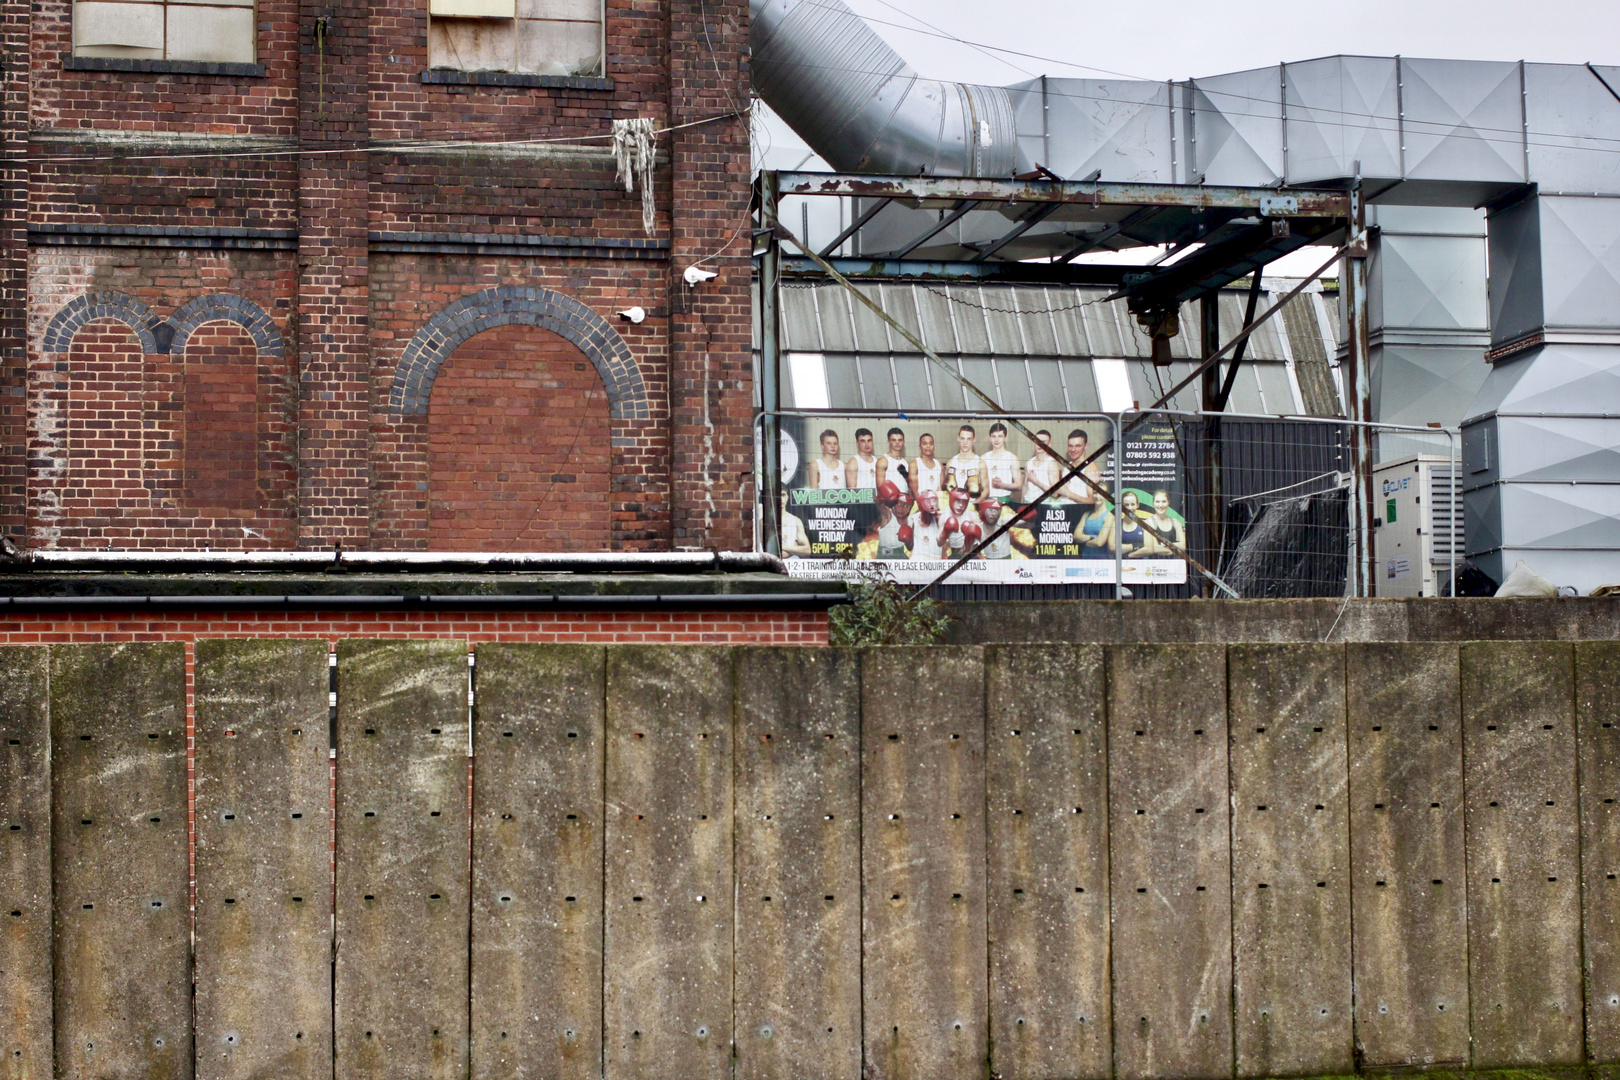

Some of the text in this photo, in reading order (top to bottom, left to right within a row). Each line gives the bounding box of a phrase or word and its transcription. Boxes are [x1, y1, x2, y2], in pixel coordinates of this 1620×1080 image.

[792, 489, 874, 504] WELCOME
[815, 508, 848, 518] MONDAY
[1046, 510, 1066, 520] ALSO
[808, 520, 856, 530] WEDNESDAY
[1041, 521, 1070, 532] SUNDAY
[818, 532, 846, 542] FRIDAY
[1039, 532, 1074, 544] MORNING
[812, 543, 830, 554] 5PM
[1035, 544, 1056, 555] 11AM
[1062, 544, 1079, 555] 1PM
[807, 562, 837, 570] TRAINING
[895, 562, 918, 570] PLEASE
[920, 562, 946, 570] ENQUIRE
[962, 562, 986, 570] DETAILS
